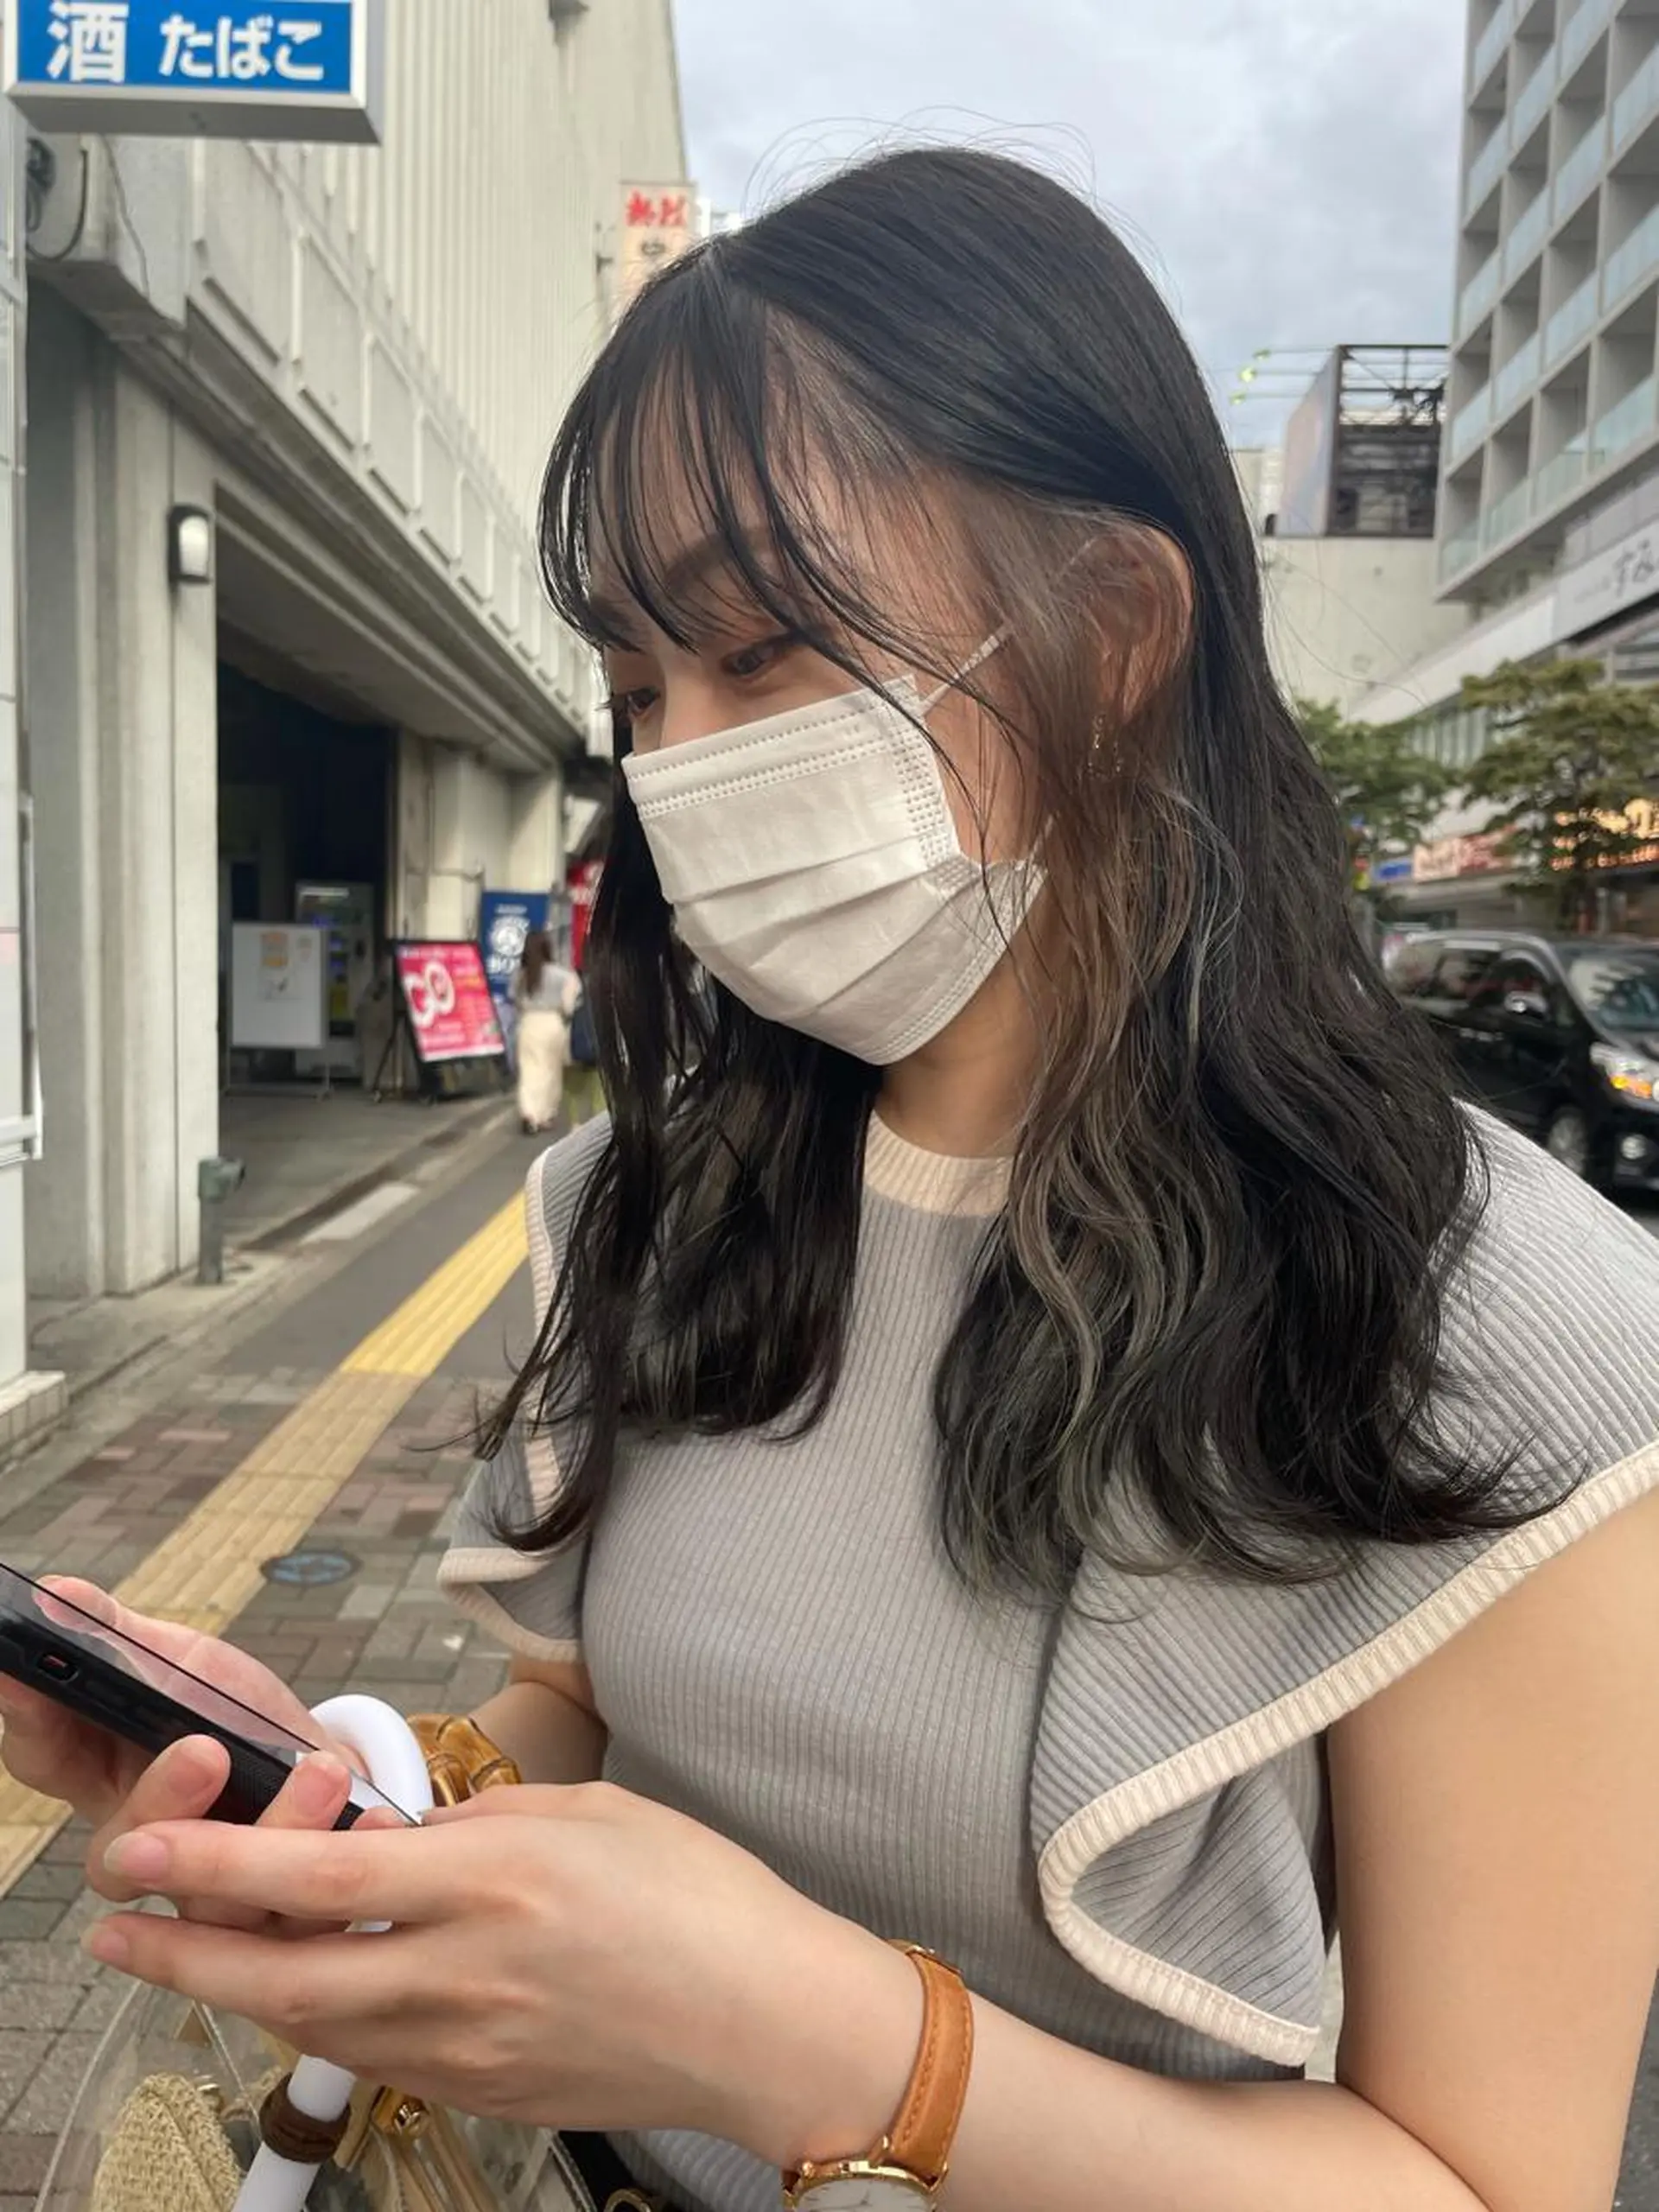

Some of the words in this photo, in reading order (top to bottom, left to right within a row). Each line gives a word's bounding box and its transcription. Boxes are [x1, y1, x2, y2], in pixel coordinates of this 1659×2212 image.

[47, 0, 129, 83] 酒
[159, 14, 324, 80] たばこ
